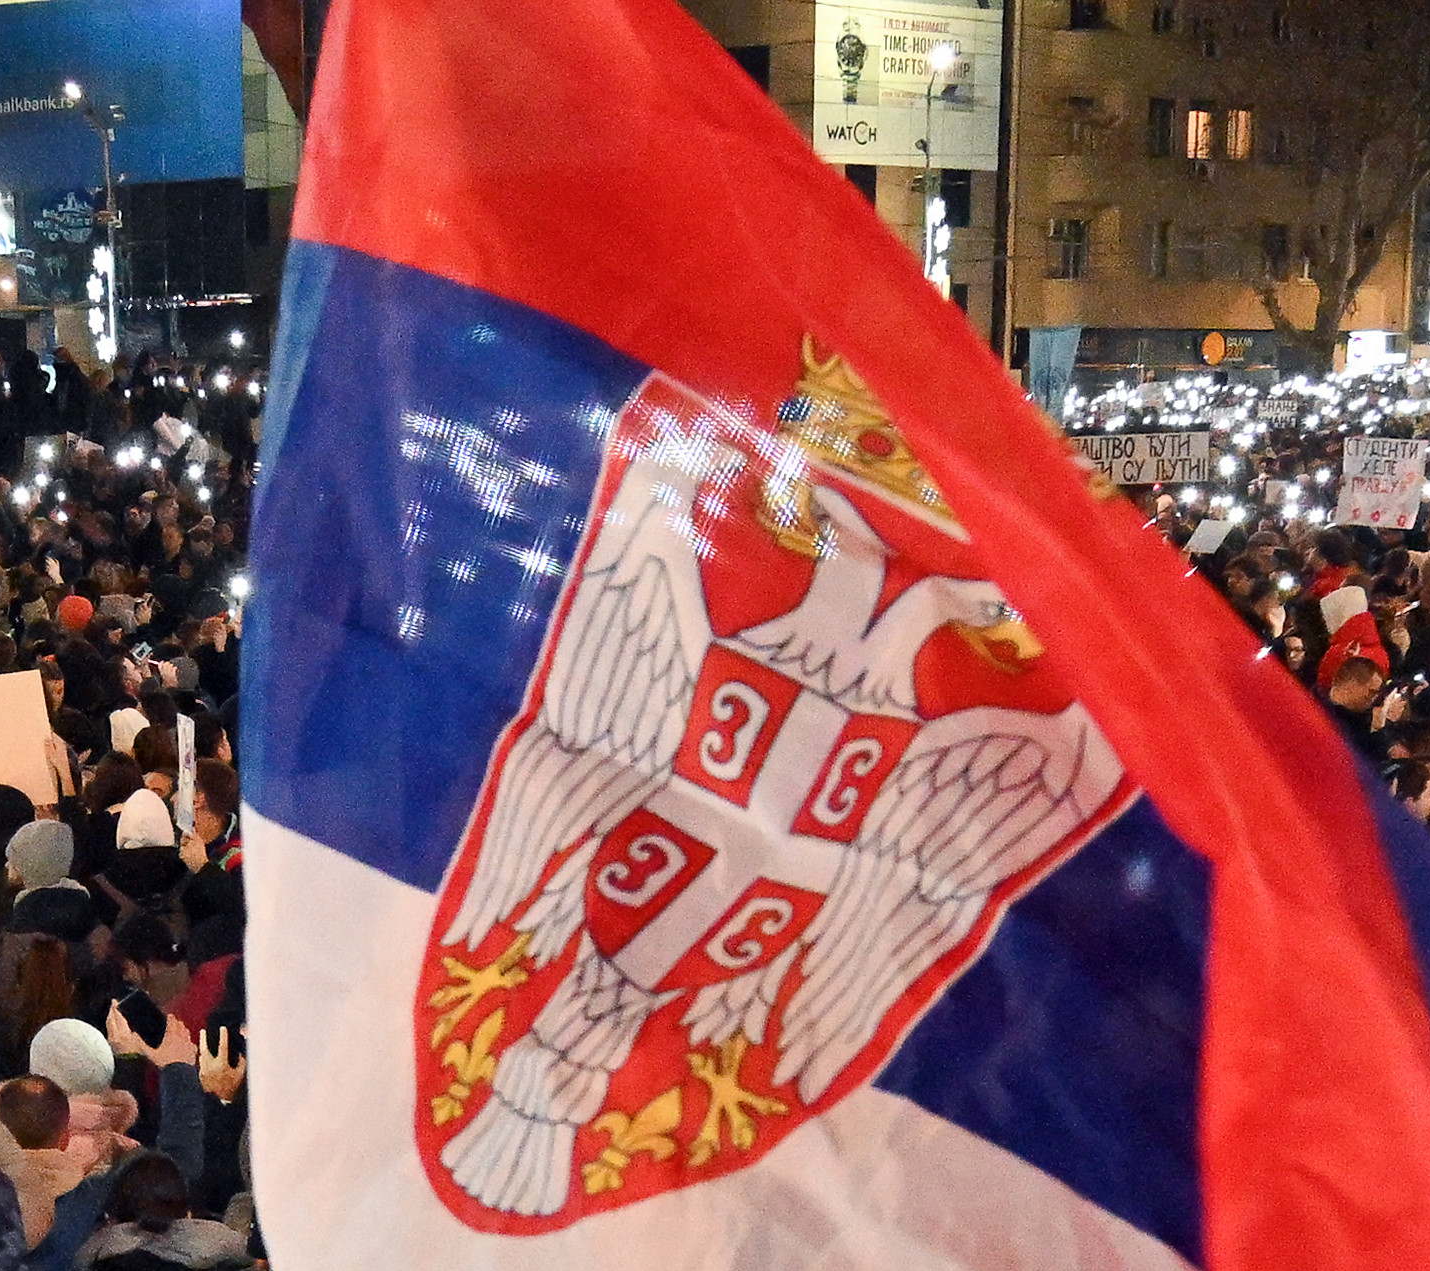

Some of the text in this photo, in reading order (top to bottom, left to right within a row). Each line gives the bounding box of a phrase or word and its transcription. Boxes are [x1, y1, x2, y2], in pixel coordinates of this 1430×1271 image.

[826, 121, 877, 145] WATCH
[1145, 434, 1192, 457] ЋУТИ
[1346, 438, 1419, 459] СТУДЕНТИ
[1123, 459, 1146, 482] СУ
